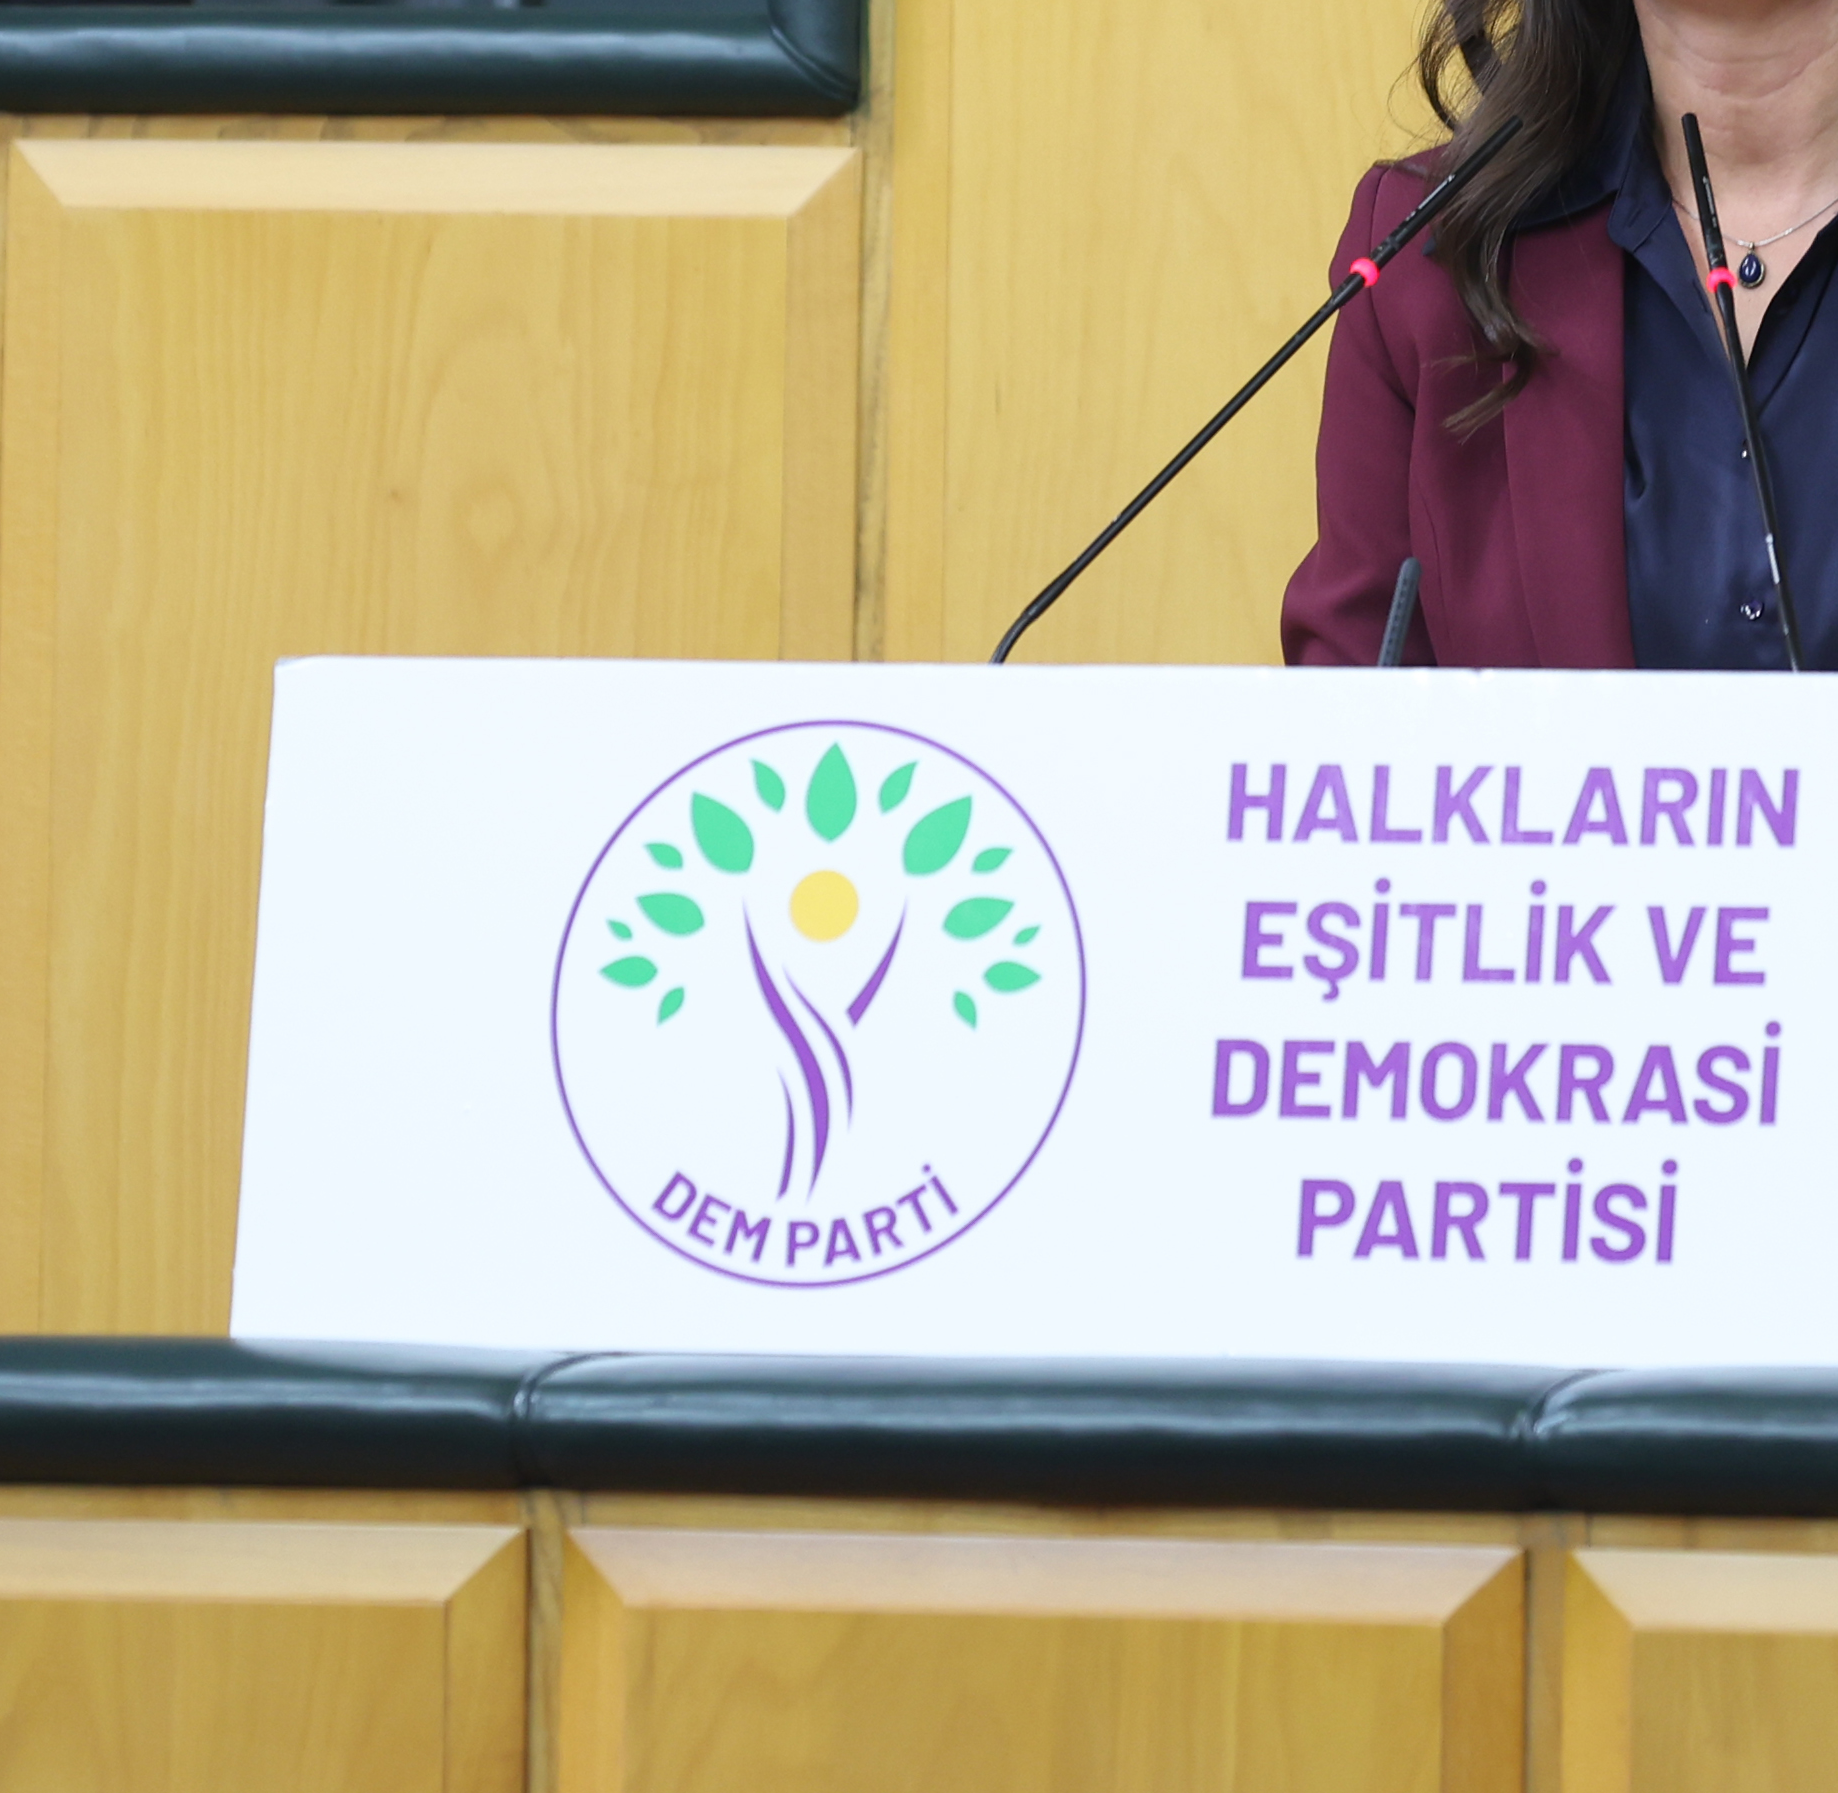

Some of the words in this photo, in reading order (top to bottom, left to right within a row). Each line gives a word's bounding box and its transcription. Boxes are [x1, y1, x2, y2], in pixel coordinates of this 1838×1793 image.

[1226, 762, 1801, 848] HALKLARIN
[1240, 877, 1615, 1002] EŞİTLİK
[1646, 905, 1771, 986] VE
[1210, 1020, 1783, 1126] DEMOKRASİ
[651, 1171, 772, 1263] DEM
[785, 1163, 960, 1268] PARTİ
[1295, 1157, 1680, 1264] PARTİSİ
